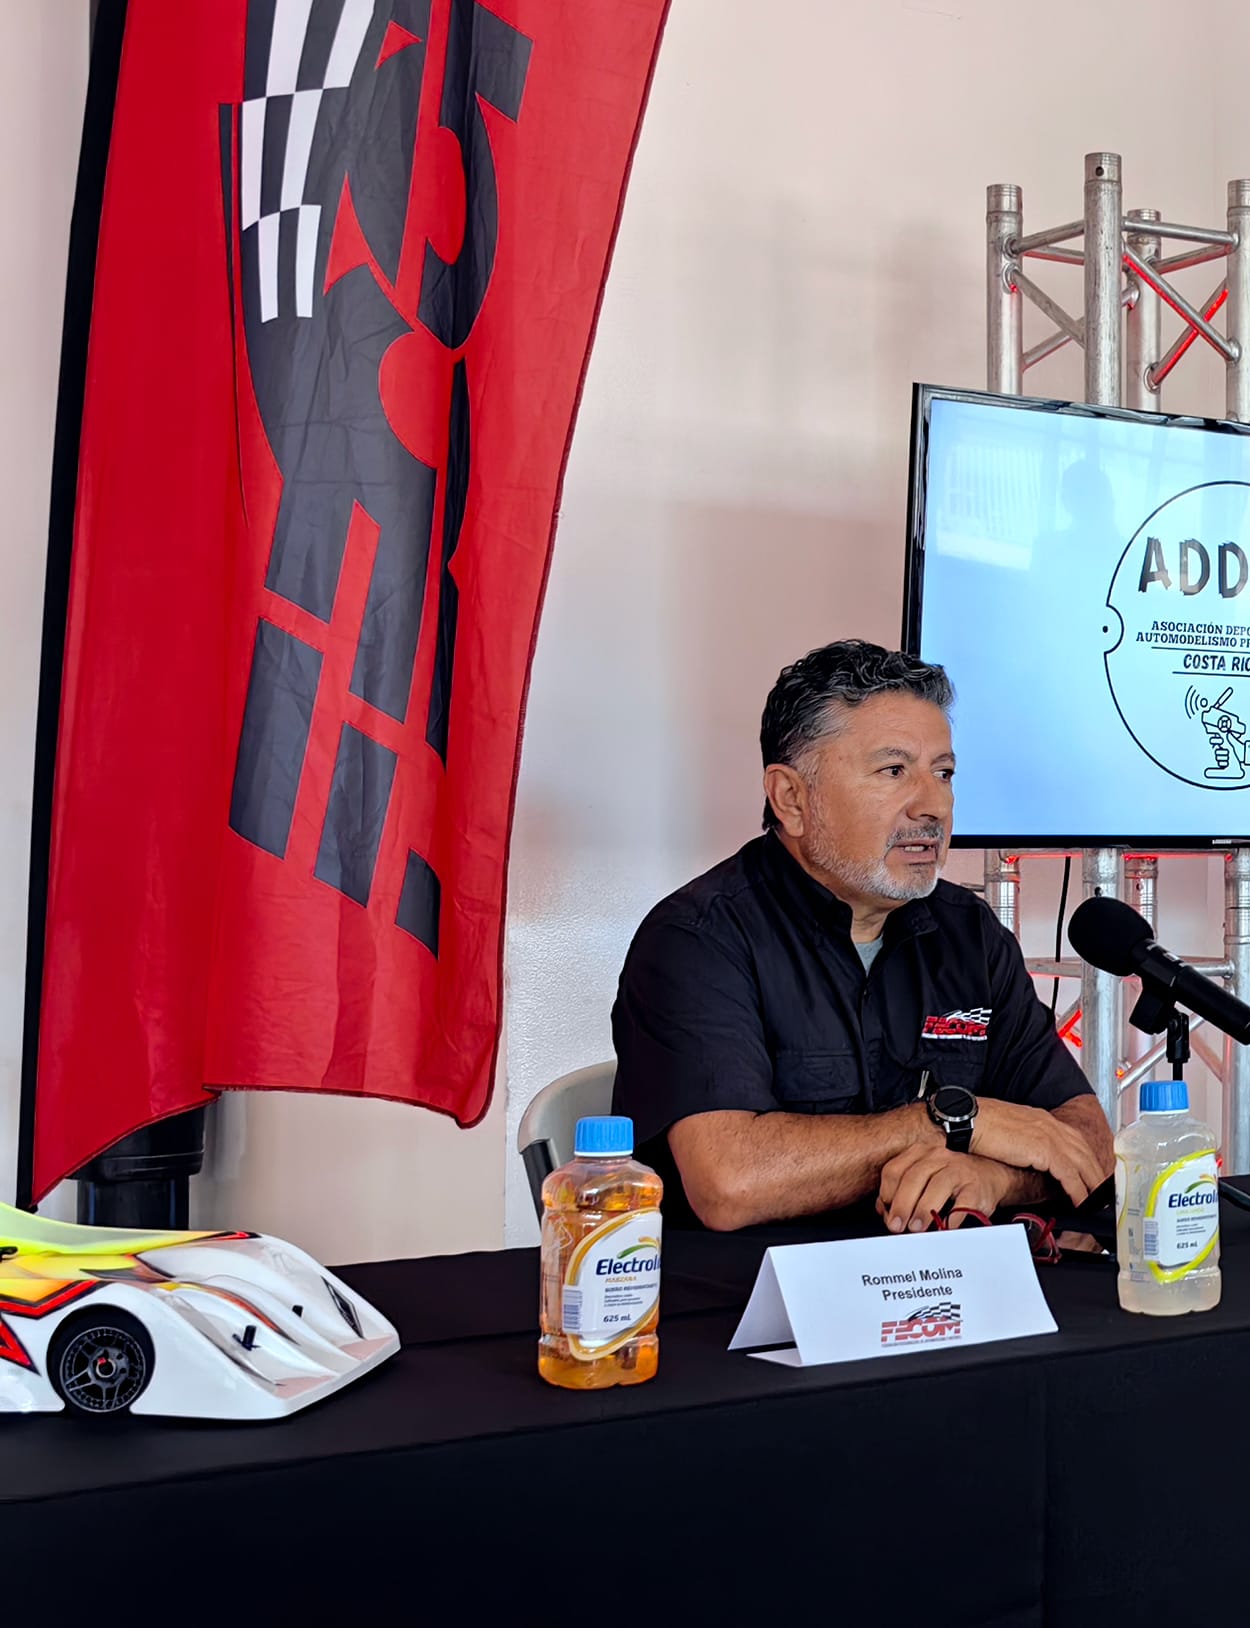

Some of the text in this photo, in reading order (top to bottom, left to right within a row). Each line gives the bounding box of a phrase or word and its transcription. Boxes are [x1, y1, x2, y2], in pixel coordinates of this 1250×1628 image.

[1151, 621, 1223, 635] ASOCIACIÓN
[1136, 632, 1237, 648] AUTOMODELISMO
[1183, 654, 1226, 671] COSTA
[861, 1268, 963, 1286] Rommel Molina
[881, 1285, 953, 1301] Presidente
[603, 1314, 619, 1323] 625
[881, 1316, 961, 1343] FECOM
